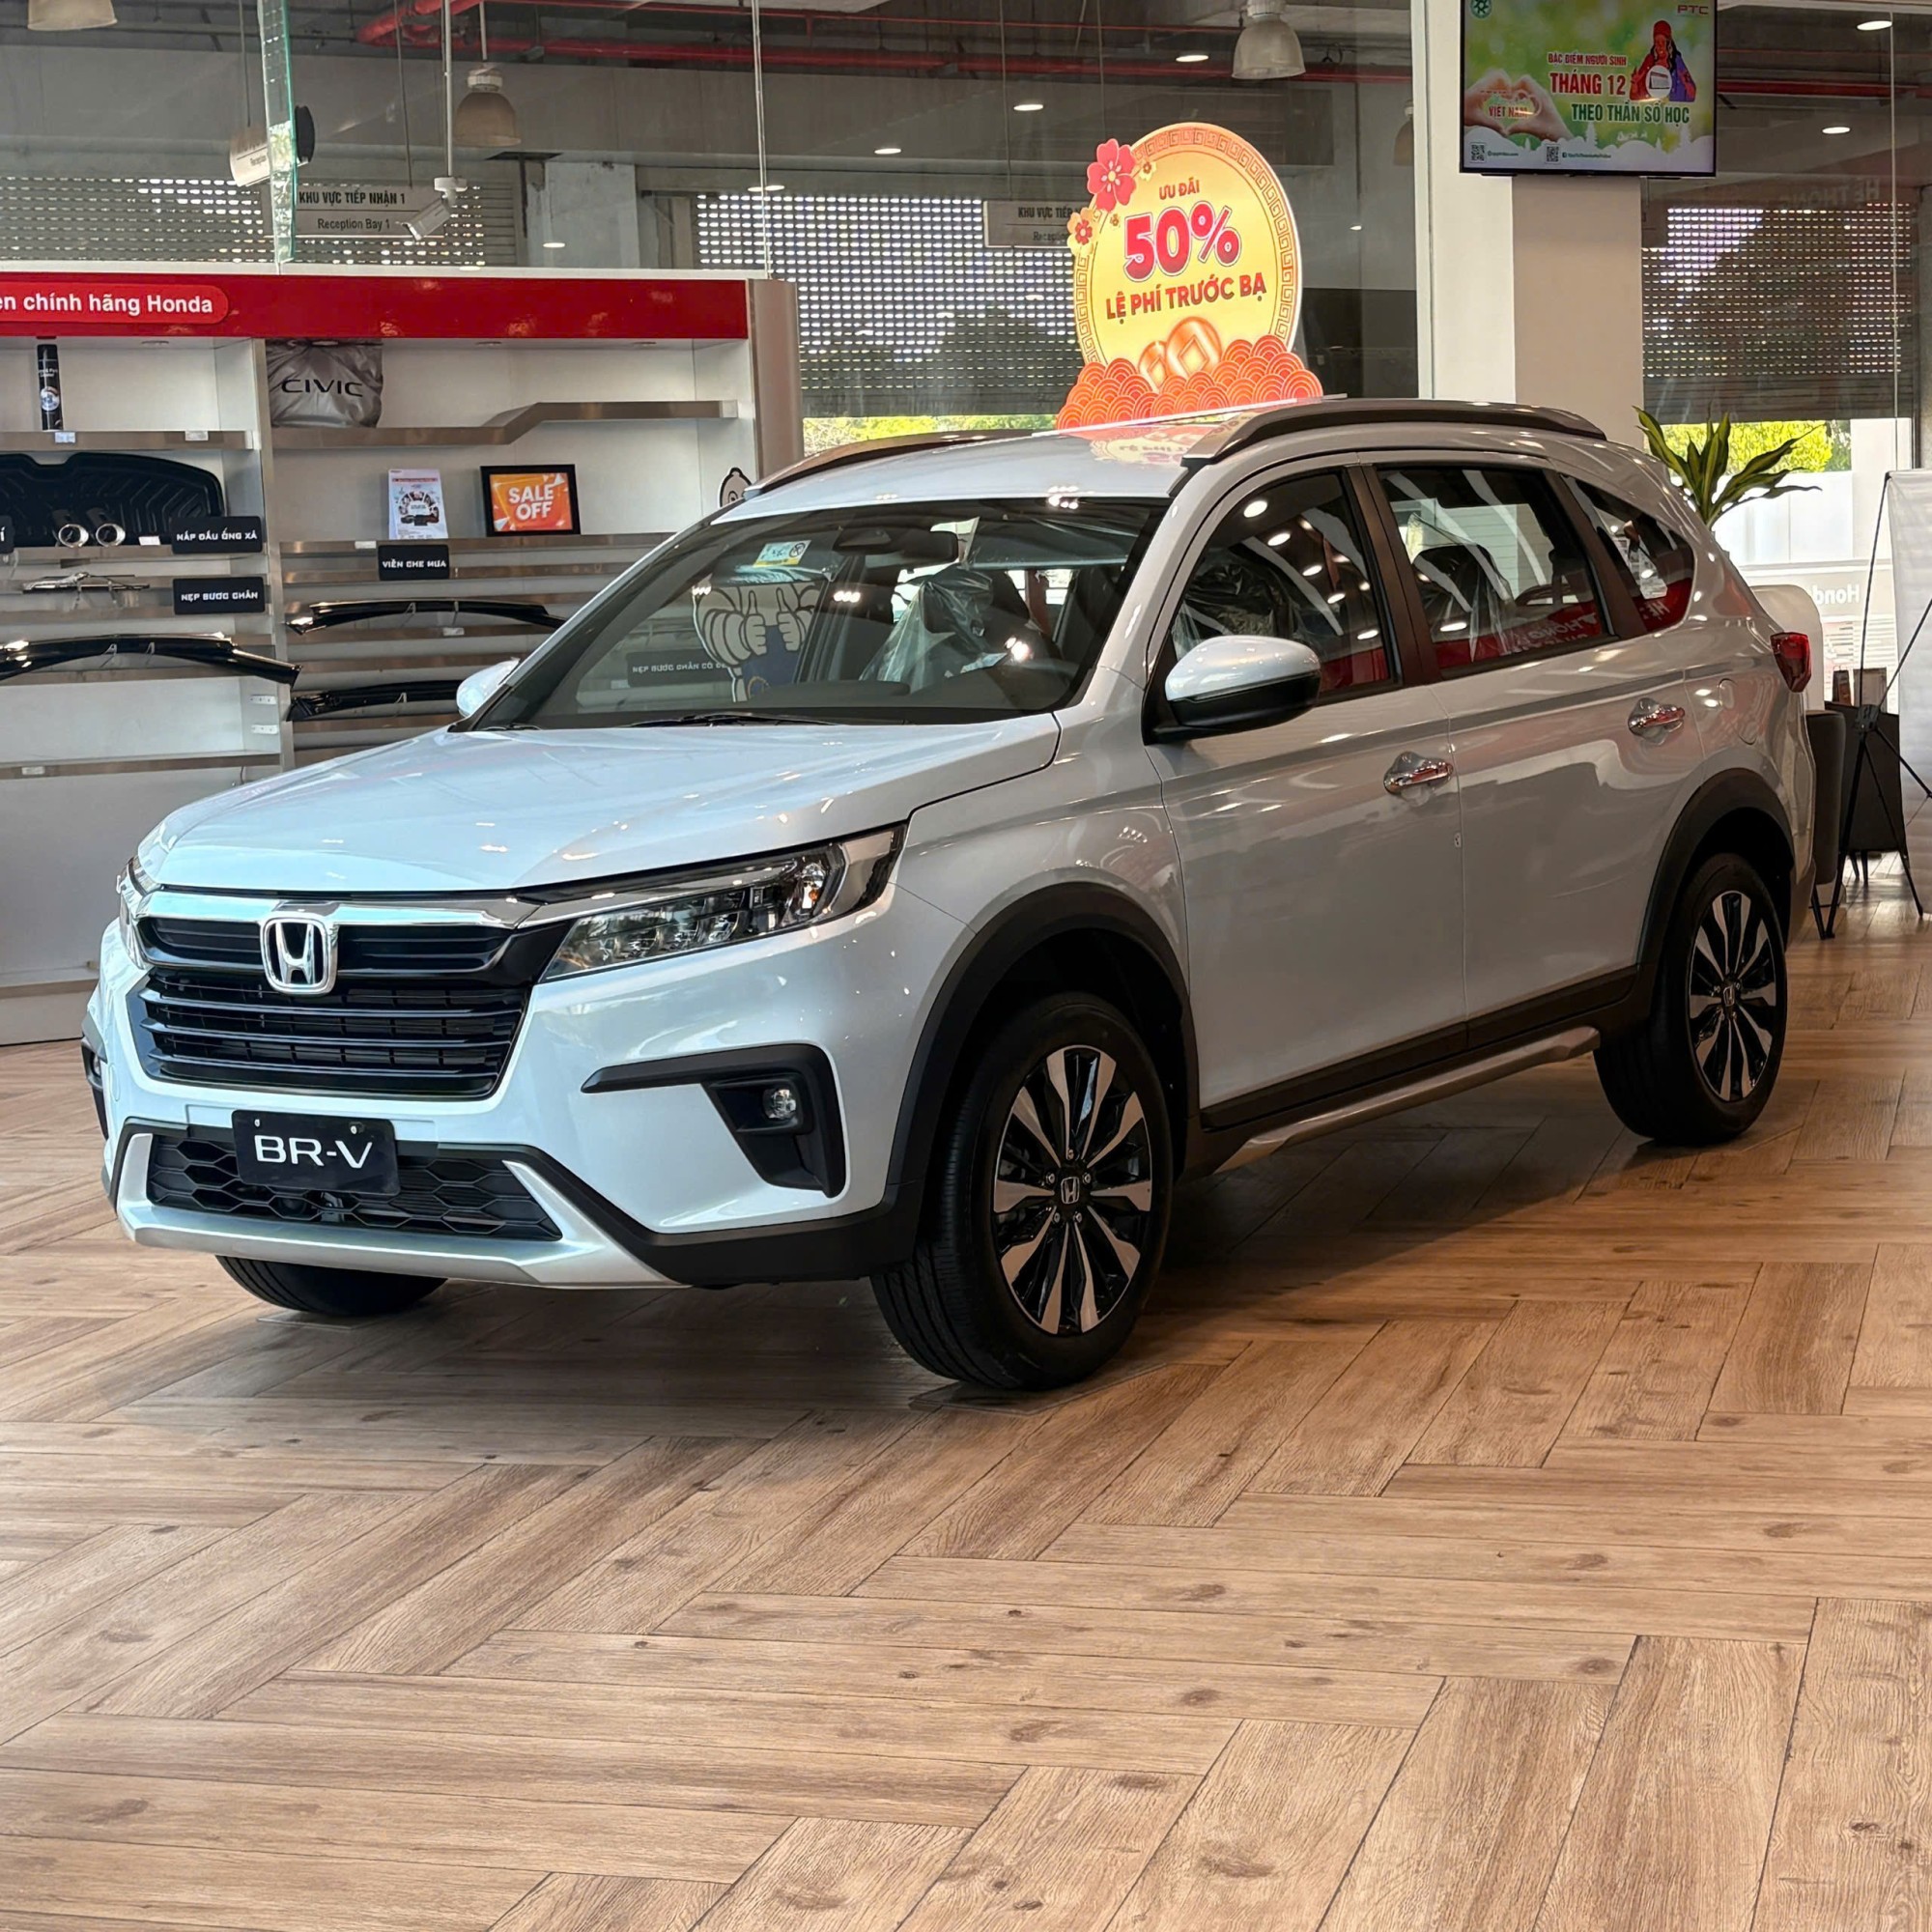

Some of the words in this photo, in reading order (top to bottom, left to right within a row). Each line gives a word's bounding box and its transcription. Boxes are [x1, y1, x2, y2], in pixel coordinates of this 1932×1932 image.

[1677, 5, 1709, 14] PTC
[1549, 70, 1602, 95] THÁNG
[1607, 74, 1626, 96] 12
[1572, 103, 1604, 122] THEO
[1664, 106, 1690, 128] HỌC
[299, 192, 322, 204] KHU
[324, 190, 342, 207] VỰC
[345, 187, 366, 204] TIẾP
[369, 190, 398, 207] NHẬN
[400, 193, 406, 204] 1
[1159, 185, 1176, 200] ƯU
[1018, 207, 1035, 218] KHU
[318, 218, 363, 230] Reception
[366, 219, 383, 230] Bay
[385, 219, 390, 228] 1
[1123, 200, 1242, 282] 50%
[23, 293, 82, 311] chính
[89, 293, 140, 316] hãng
[147, 295, 213, 313] Honda
[1106, 291, 1126, 325] LỆ
[1130, 284, 1161, 316] PHÍ
[1165, 273, 1236, 309] TRƯỚC
[1239, 271, 1267, 302] BẠ
[281, 379, 363, 397] CIVIC
[508, 485, 554, 504] SALE
[516, 501, 553, 520] OFF
[181, 593, 200, 603] NẸP
[254, 1135, 373, 1169] BR-V
